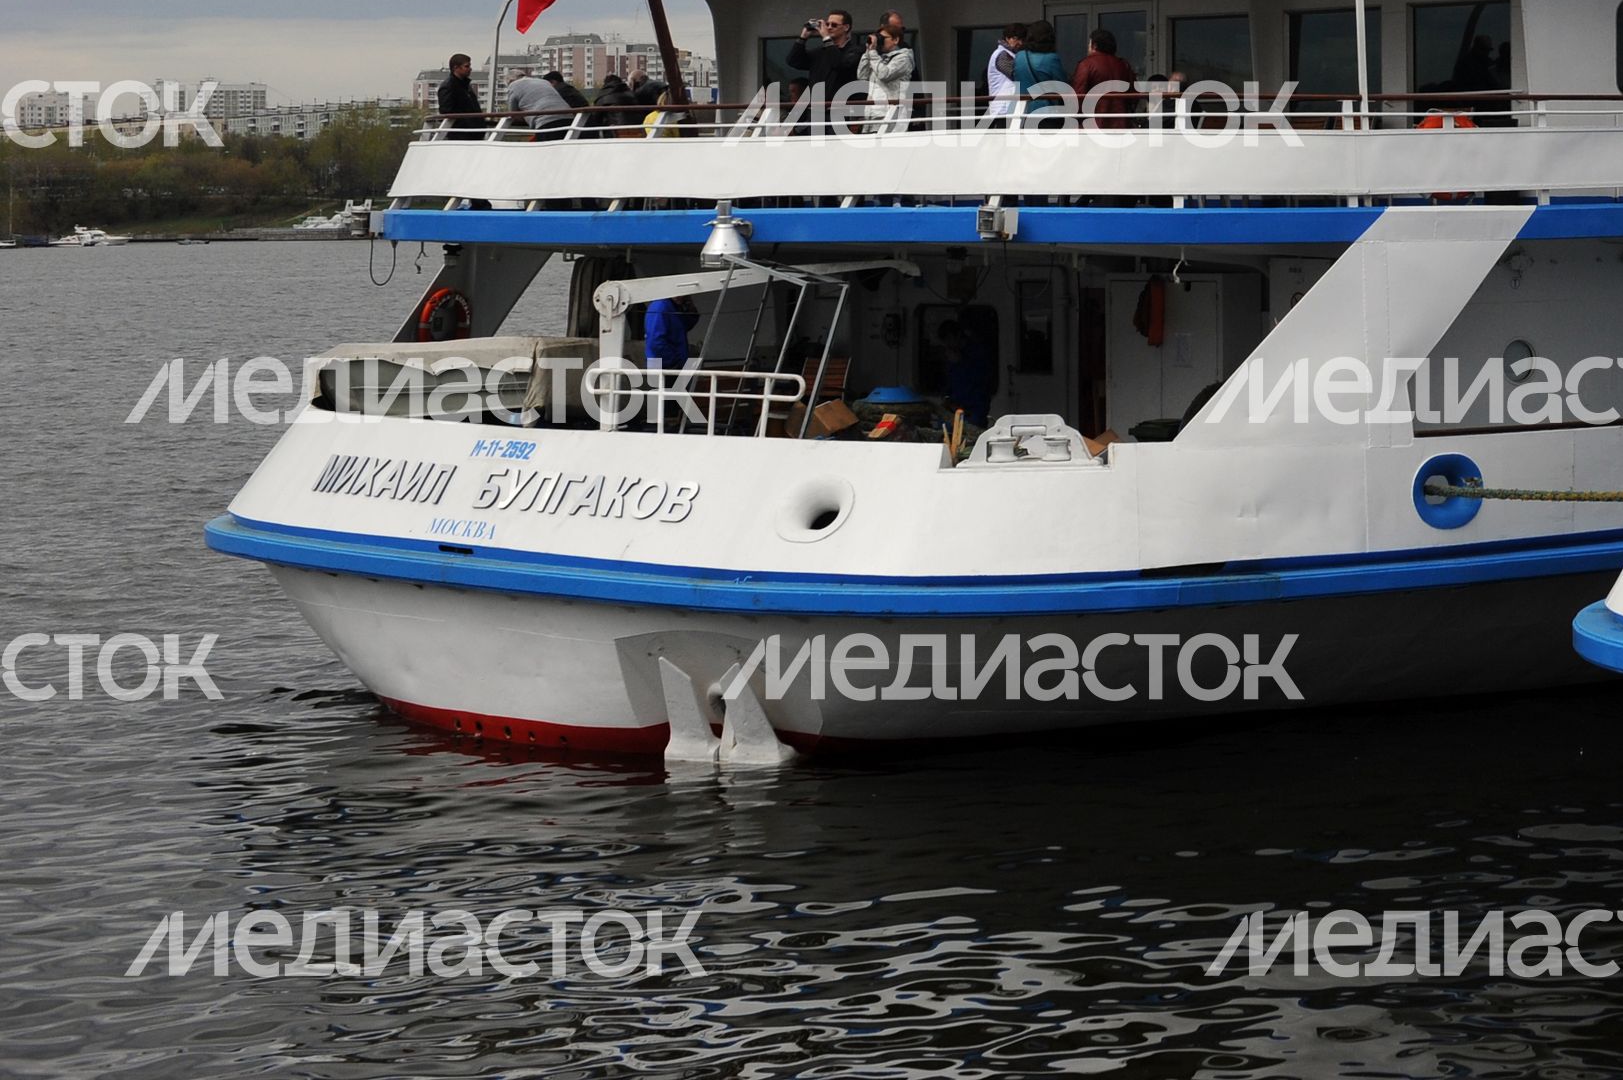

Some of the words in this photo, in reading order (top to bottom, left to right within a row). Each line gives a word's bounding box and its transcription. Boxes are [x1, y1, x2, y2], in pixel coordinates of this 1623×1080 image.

[312, 454, 458, 505] МИХАИЛ
[472, 468, 701, 523] БУЛГАКОВ
[426, 517, 496, 540] МОСКВА
